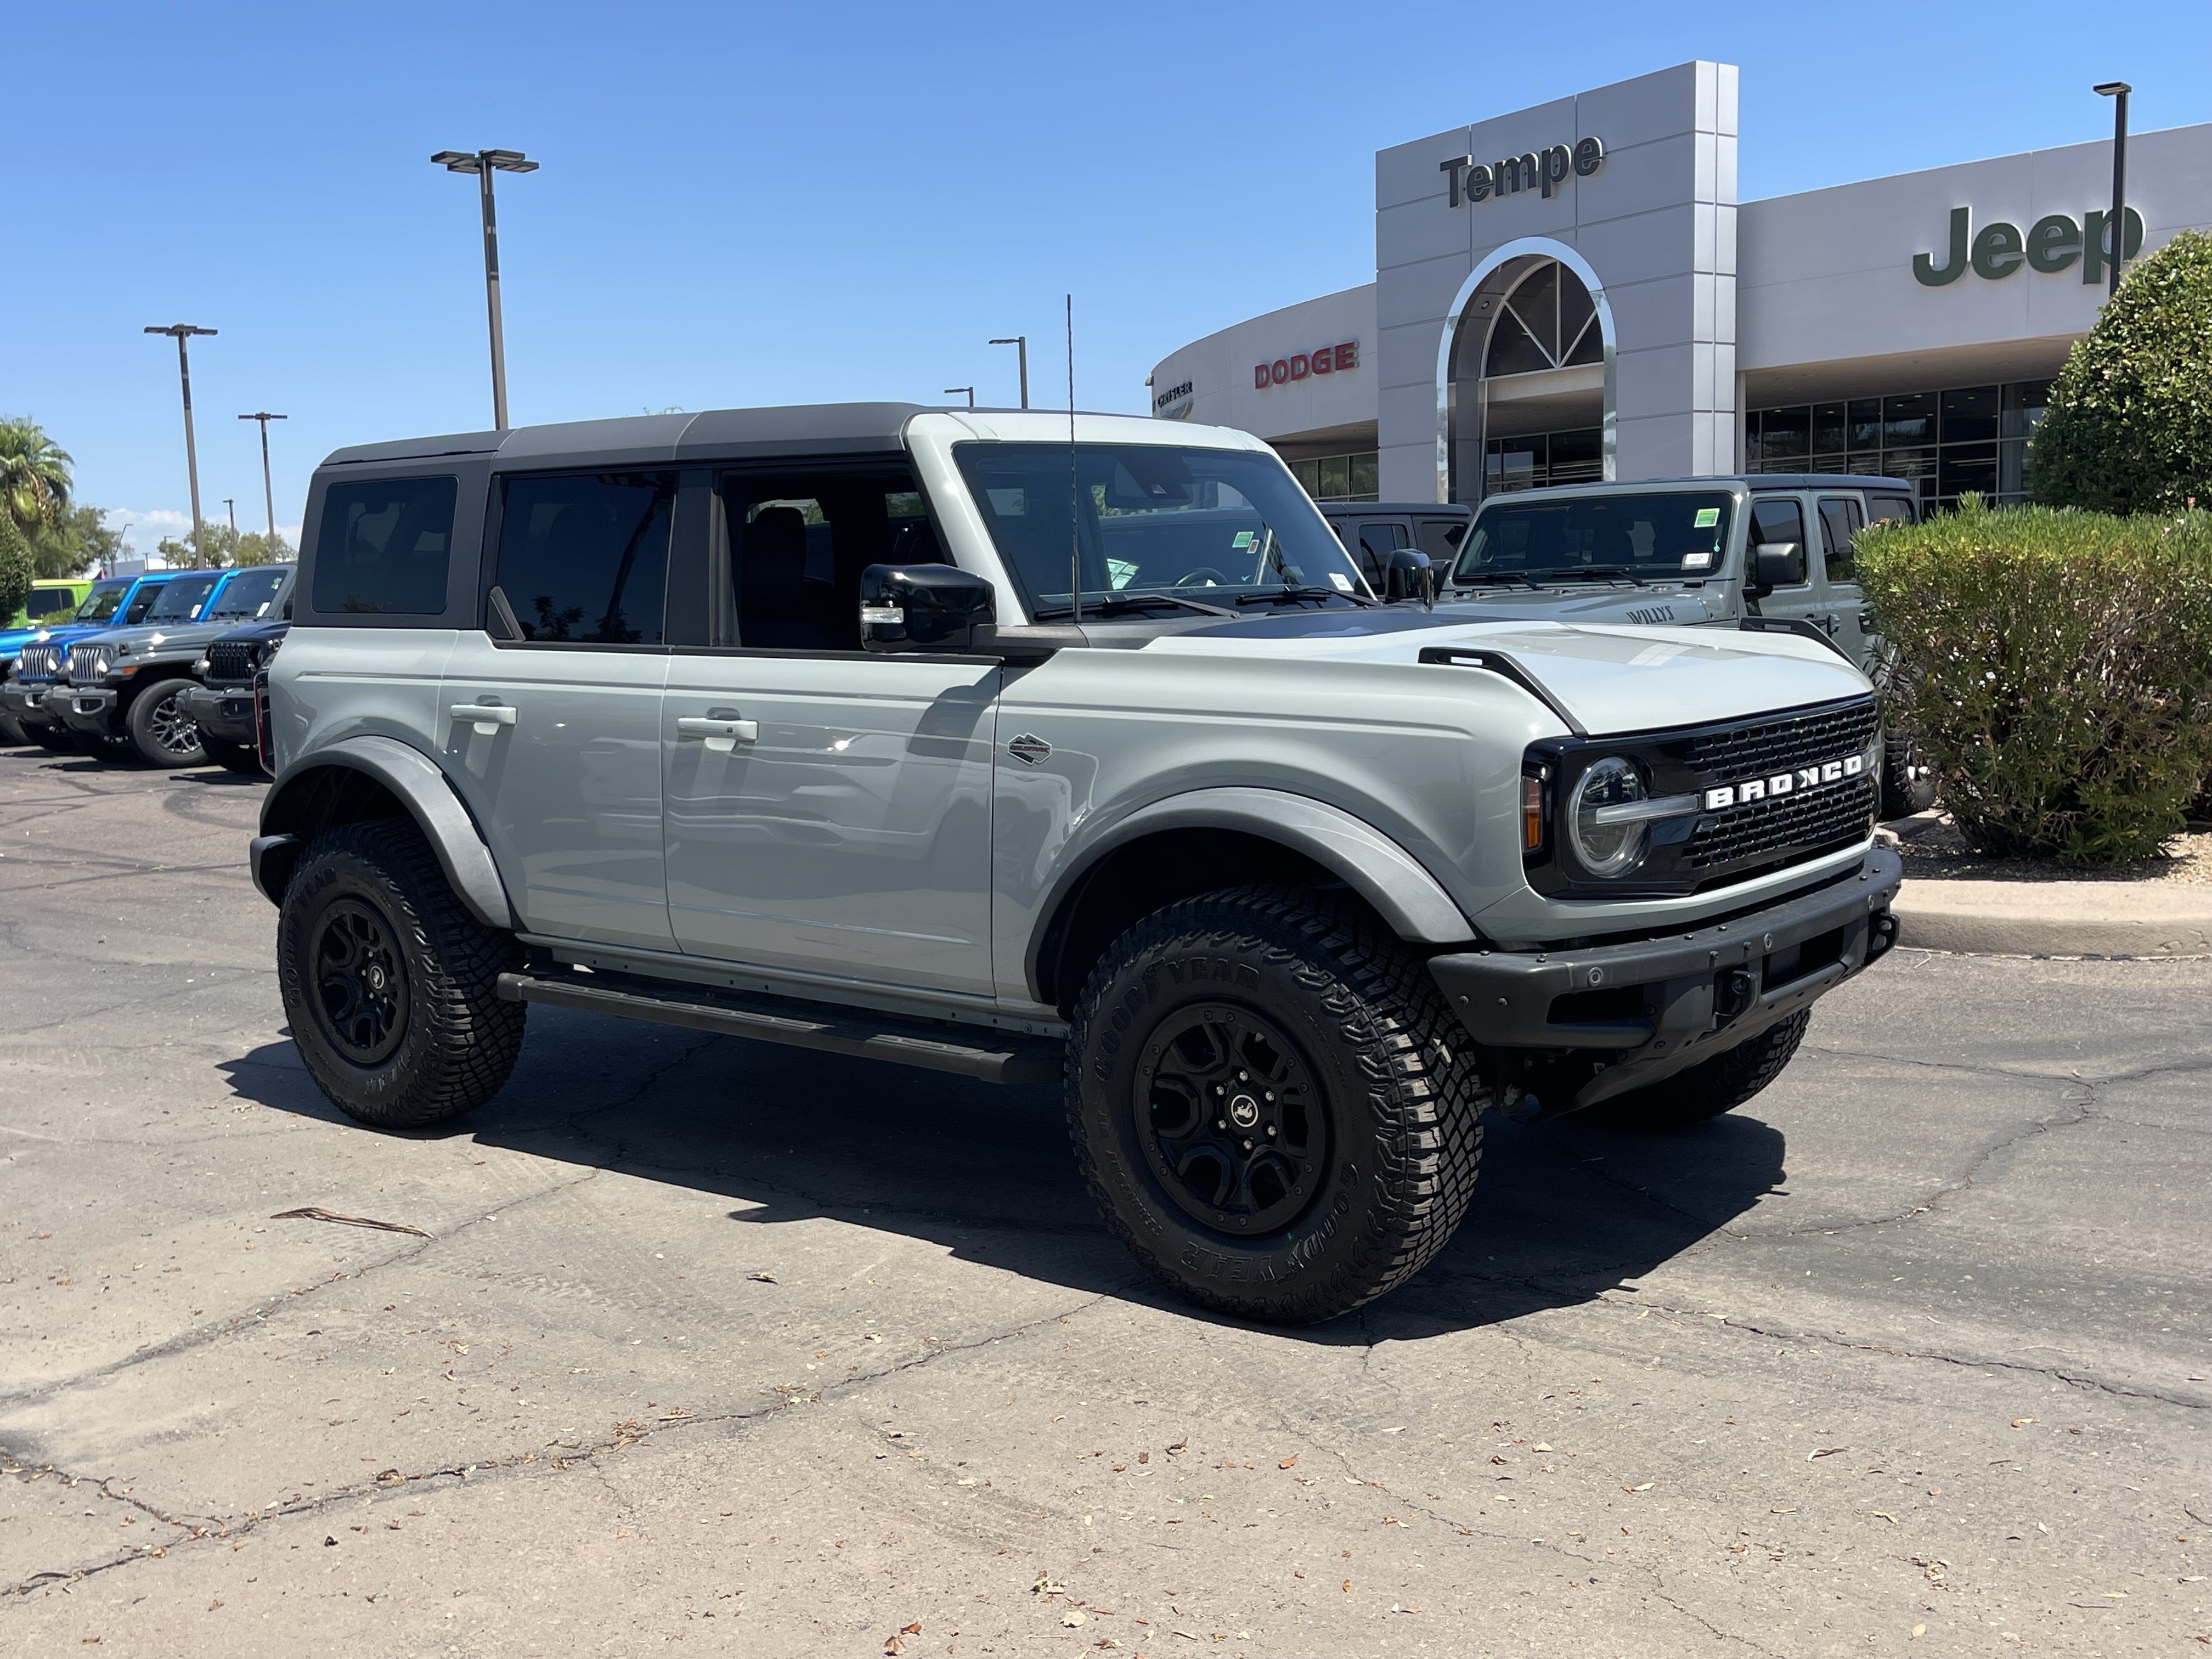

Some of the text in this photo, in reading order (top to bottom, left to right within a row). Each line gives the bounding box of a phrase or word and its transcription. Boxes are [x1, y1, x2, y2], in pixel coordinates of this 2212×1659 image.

[1440, 137, 1605, 208] Tempe
[1912, 206, 2146, 286] Jeep
[1255, 341, 1359, 390] DODGE
[1626, 605, 1674, 625] WILLYS
[1706, 755, 1862, 810] BRONCO
